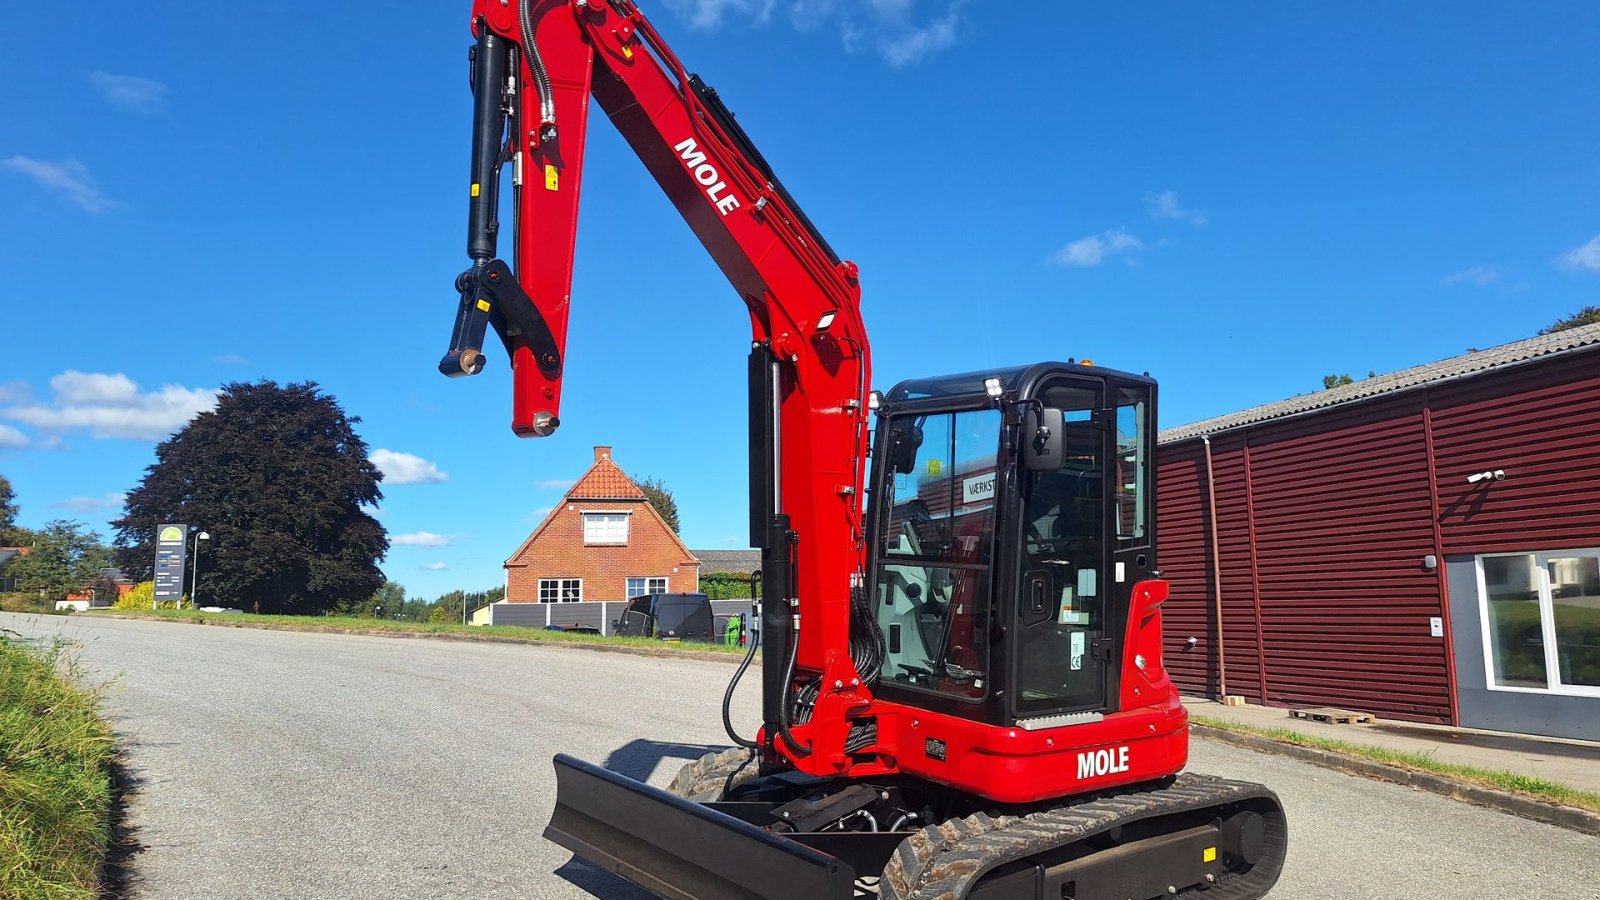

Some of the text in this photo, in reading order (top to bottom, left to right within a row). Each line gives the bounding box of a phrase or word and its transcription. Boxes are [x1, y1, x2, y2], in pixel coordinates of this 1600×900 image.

[674, 137, 740, 216] MOLE
[1071, 656, 1080, 668] CE
[1077, 746, 1129, 780] MOLE
